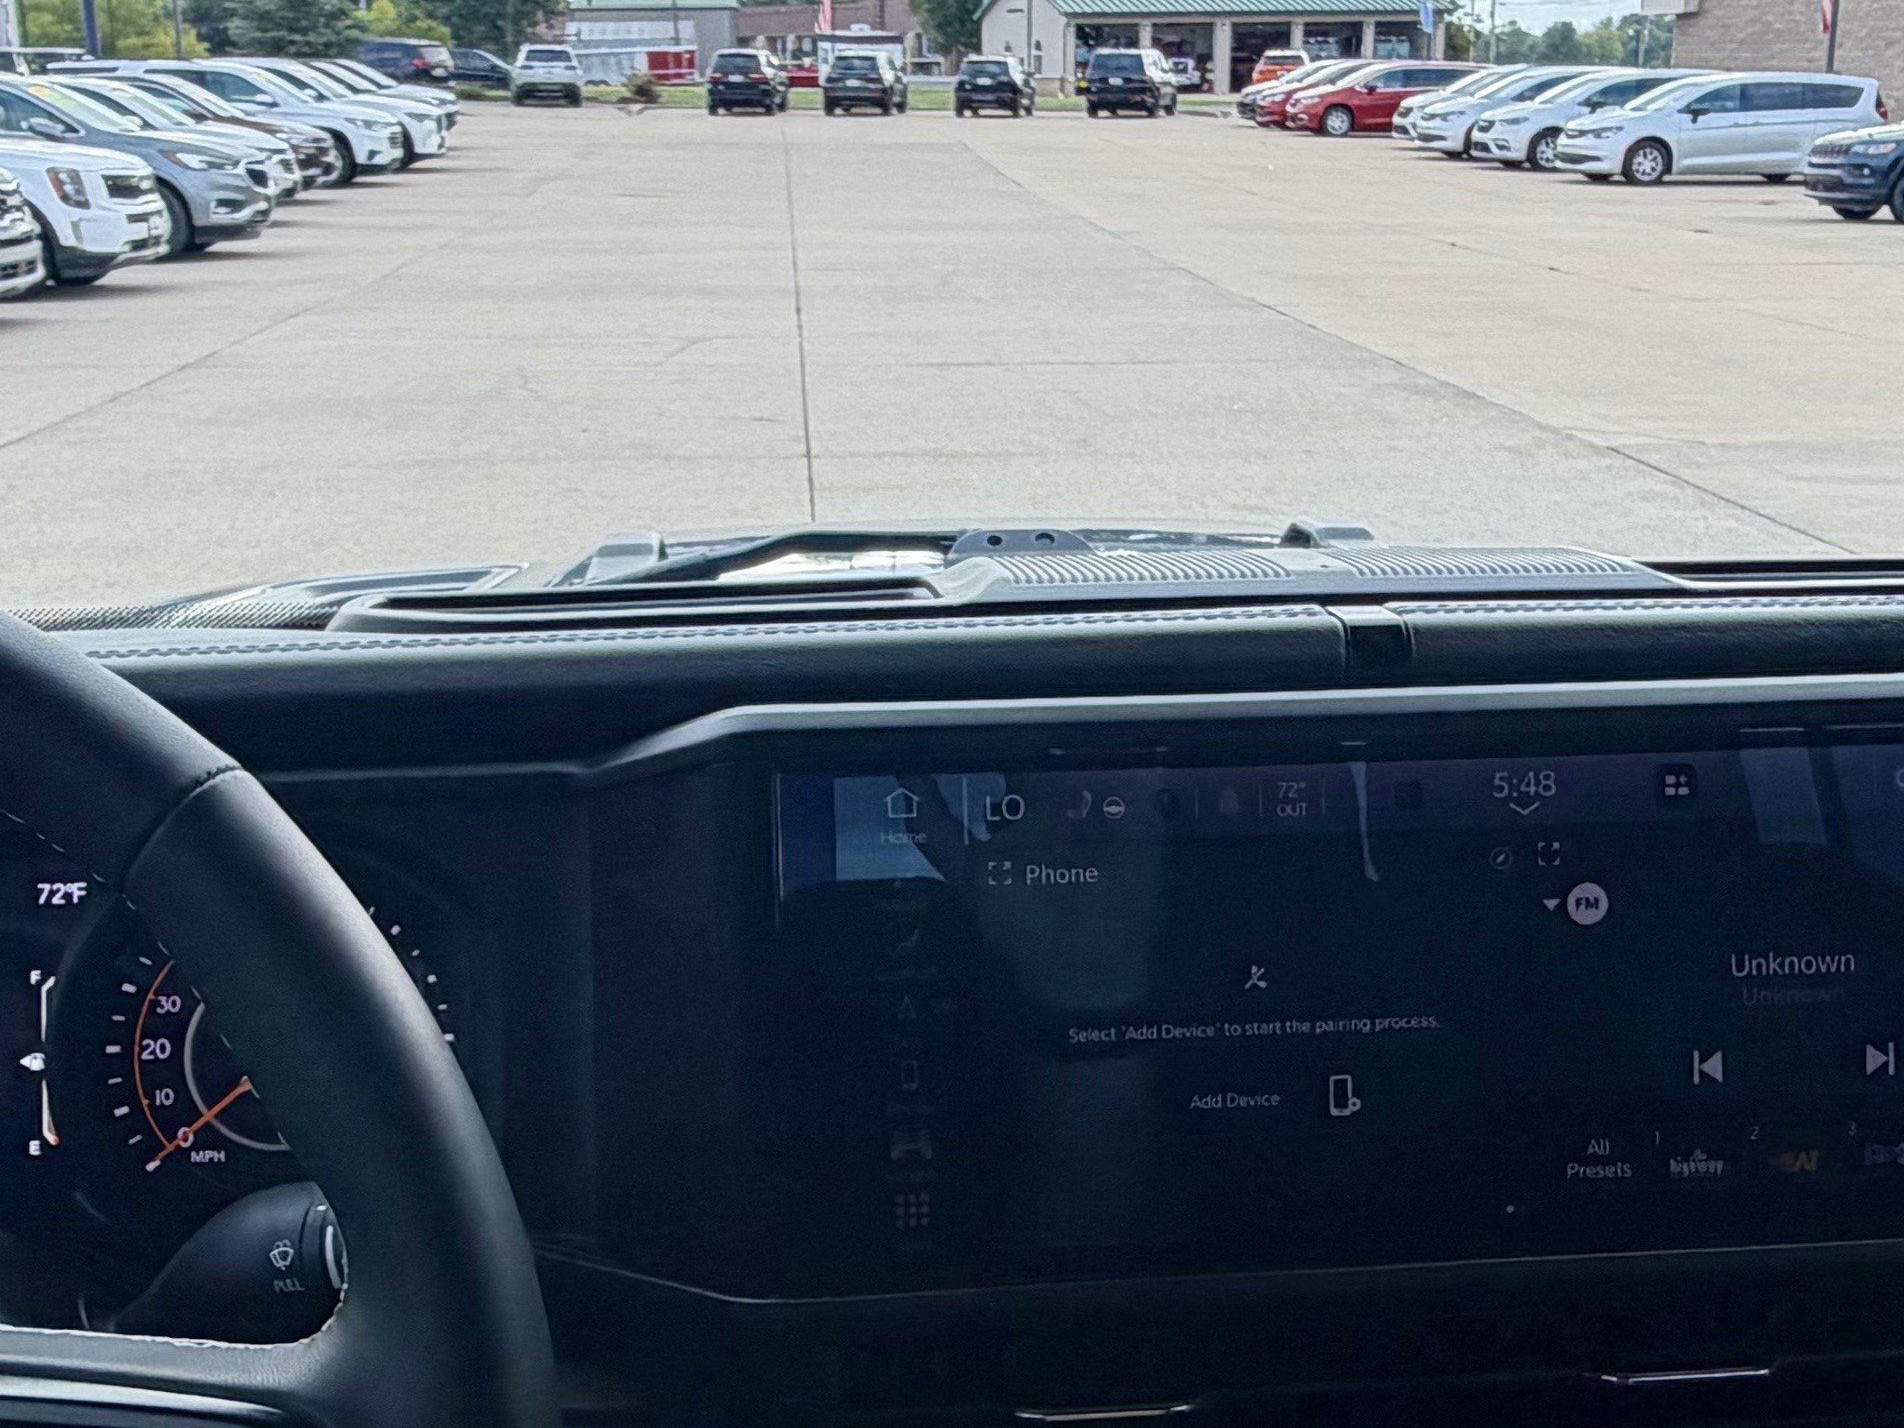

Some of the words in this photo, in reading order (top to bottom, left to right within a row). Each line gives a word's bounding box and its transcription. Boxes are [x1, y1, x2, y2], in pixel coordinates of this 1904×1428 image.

[1492, 771, 1556, 799] 5:48
[984, 793, 1027, 822] LO
[1275, 799, 1311, 818] OUT
[1025, 862, 1099, 887] Phone
[1730, 949, 1857, 978] Unknown
[29, 969, 43, 984] F
[155, 994, 182, 1014] 30
[1067, 1023, 1117, 1044] Select
[1223, 1020, 1241, 1037] to
[1243, 1018, 1282, 1037] start
[1284, 1017, 1312, 1035] the
[1313, 1016, 1372, 1039] pairing
[140, 1037, 172, 1061] 20
[154, 1087, 175, 1107] 10
[1189, 1092, 1222, 1111] Add
[1224, 1089, 1282, 1109] Device
[1748, 1124, 1761, 1141] 2
[28, 1140, 42, 1156] E
[190, 1149, 226, 1164] MPH
[1585, 1136, 1611, 1157] All
[1566, 1160, 1634, 1181] Presets
